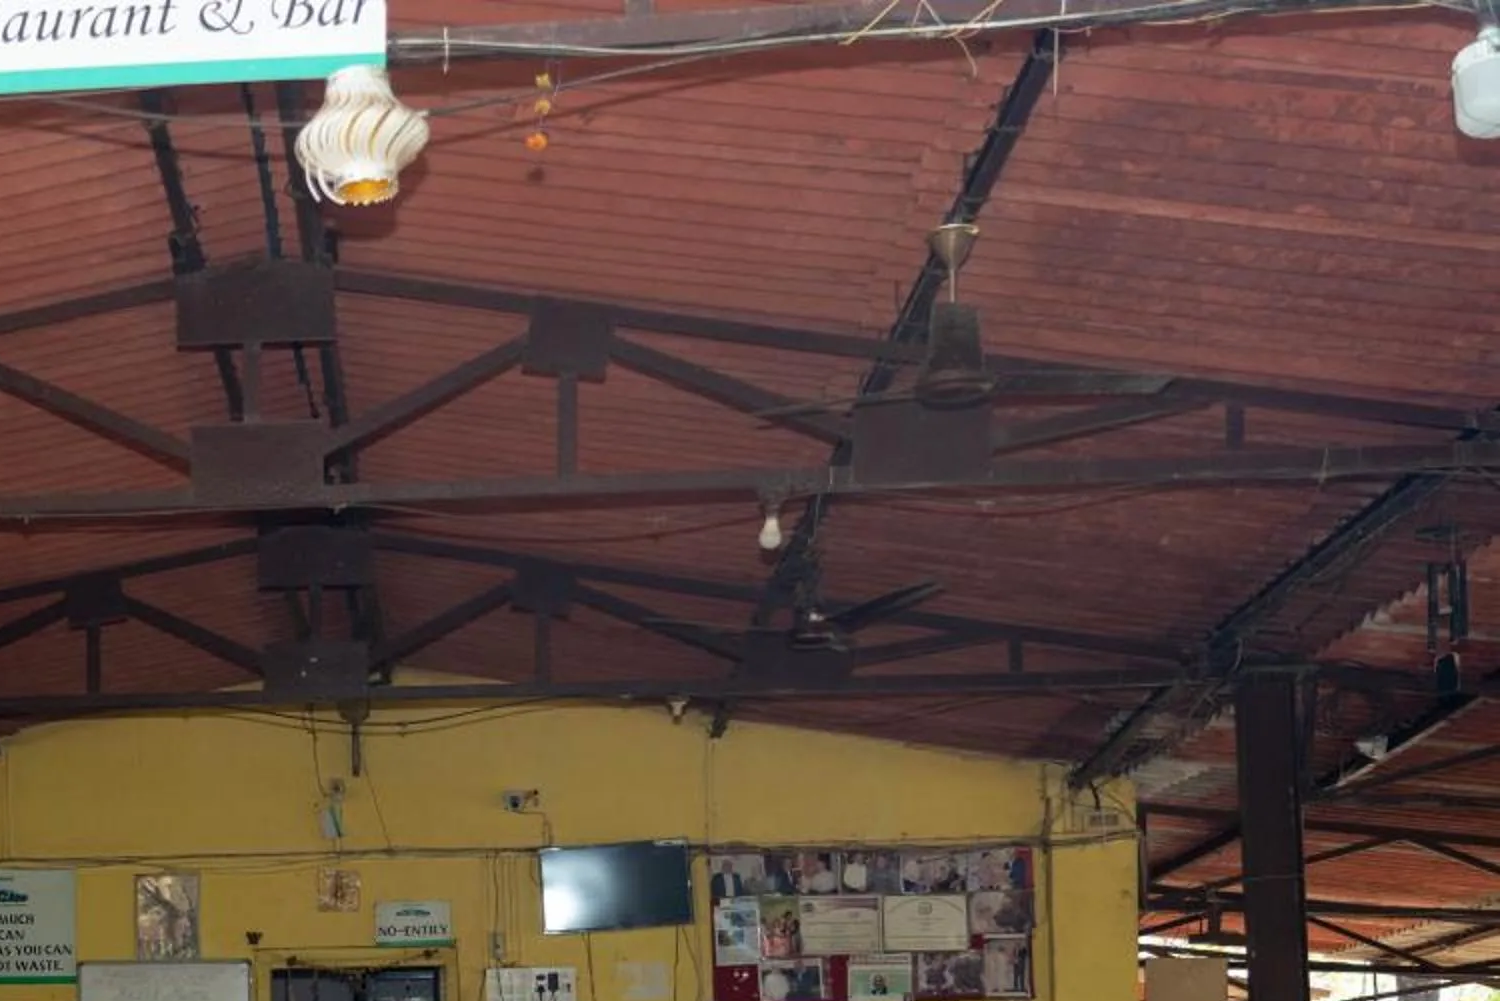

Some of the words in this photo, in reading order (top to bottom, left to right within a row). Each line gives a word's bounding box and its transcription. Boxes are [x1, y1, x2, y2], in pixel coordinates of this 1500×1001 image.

[198, 0, 254, 34] &
[271, 0, 369, 28] Bar
[15, 945, 41, 956] YOU
[42, 944, 73, 955] CAN
